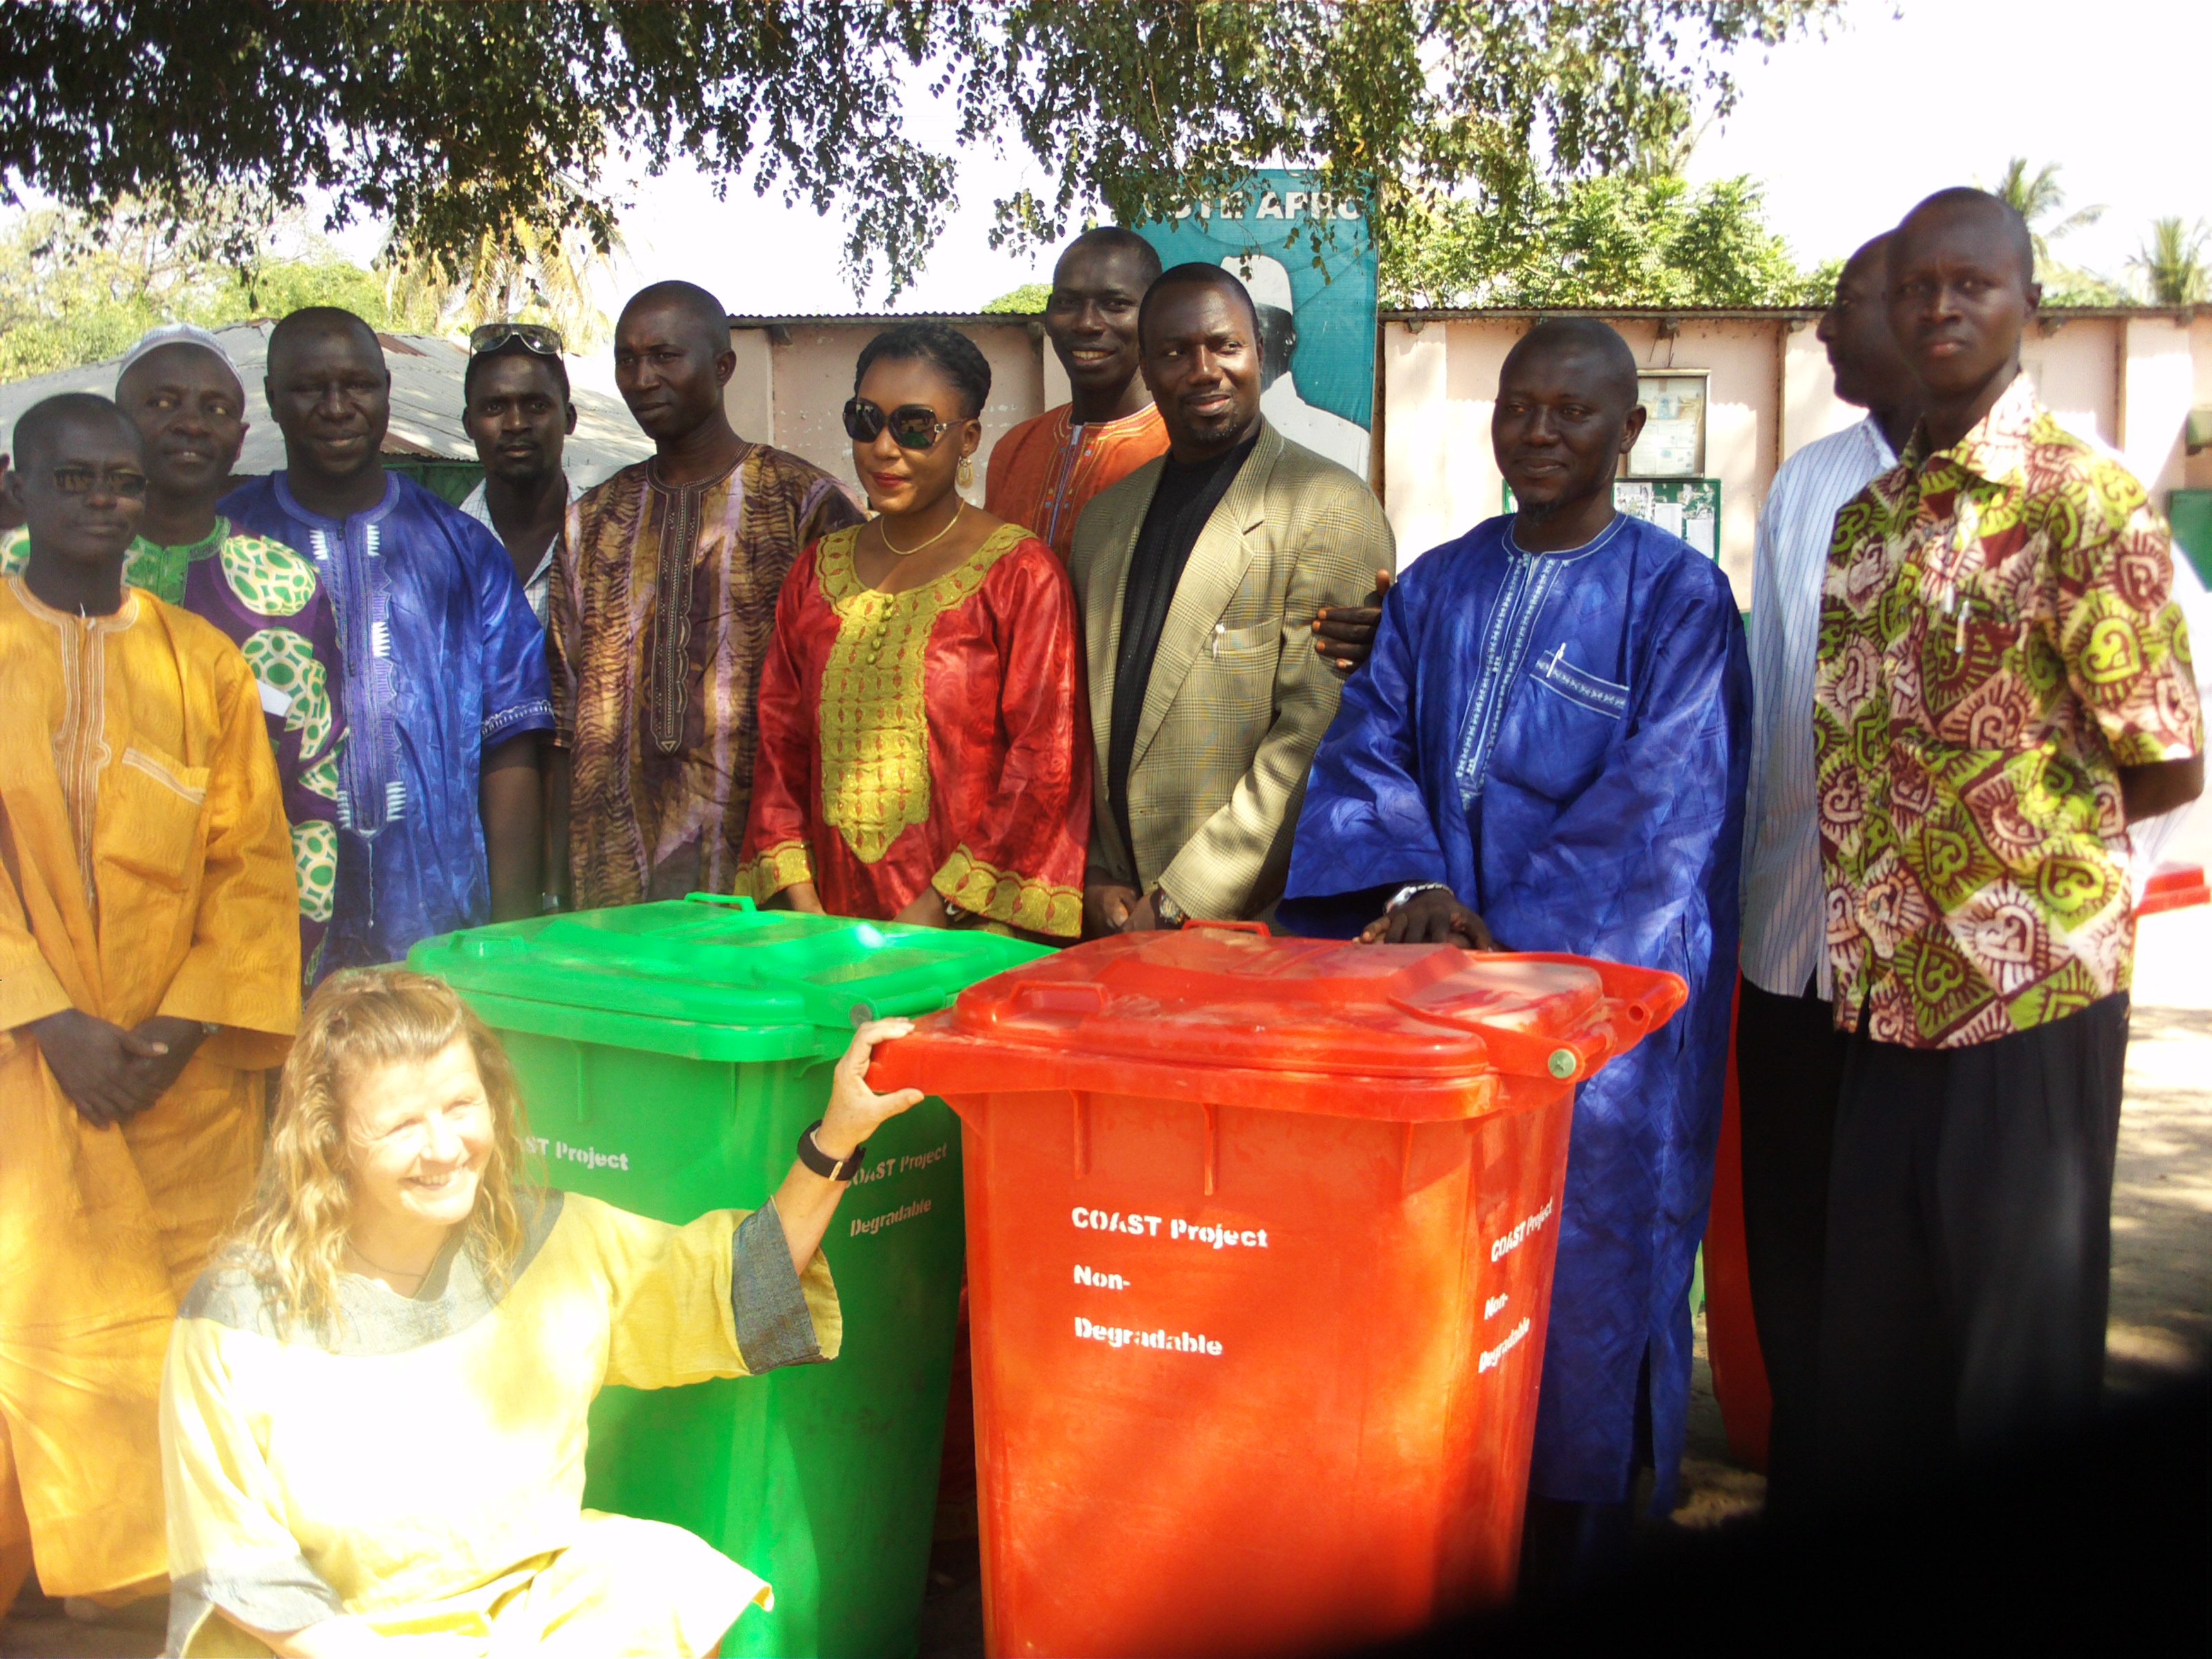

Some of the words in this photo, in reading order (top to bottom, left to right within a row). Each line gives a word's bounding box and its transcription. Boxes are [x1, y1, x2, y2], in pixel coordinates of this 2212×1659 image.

[556, 1141, 628, 1171] Project
[847, 1159, 896, 1189] OAST
[899, 1143, 947, 1173] Project
[850, 1198, 931, 1237] Degradable
[1071, 1207, 1161, 1237] COAST
[1170, 1219, 1268, 1249] Project
[1491, 1221, 1526, 1262] COAST
[1526, 1196, 1553, 1236] Project
[1074, 1264, 1131, 1290] Non-
[1484, 1293, 1508, 1320] Non-
[1075, 1317, 1223, 1356] Degradable
[1478, 1316, 1530, 1374] Degradable
